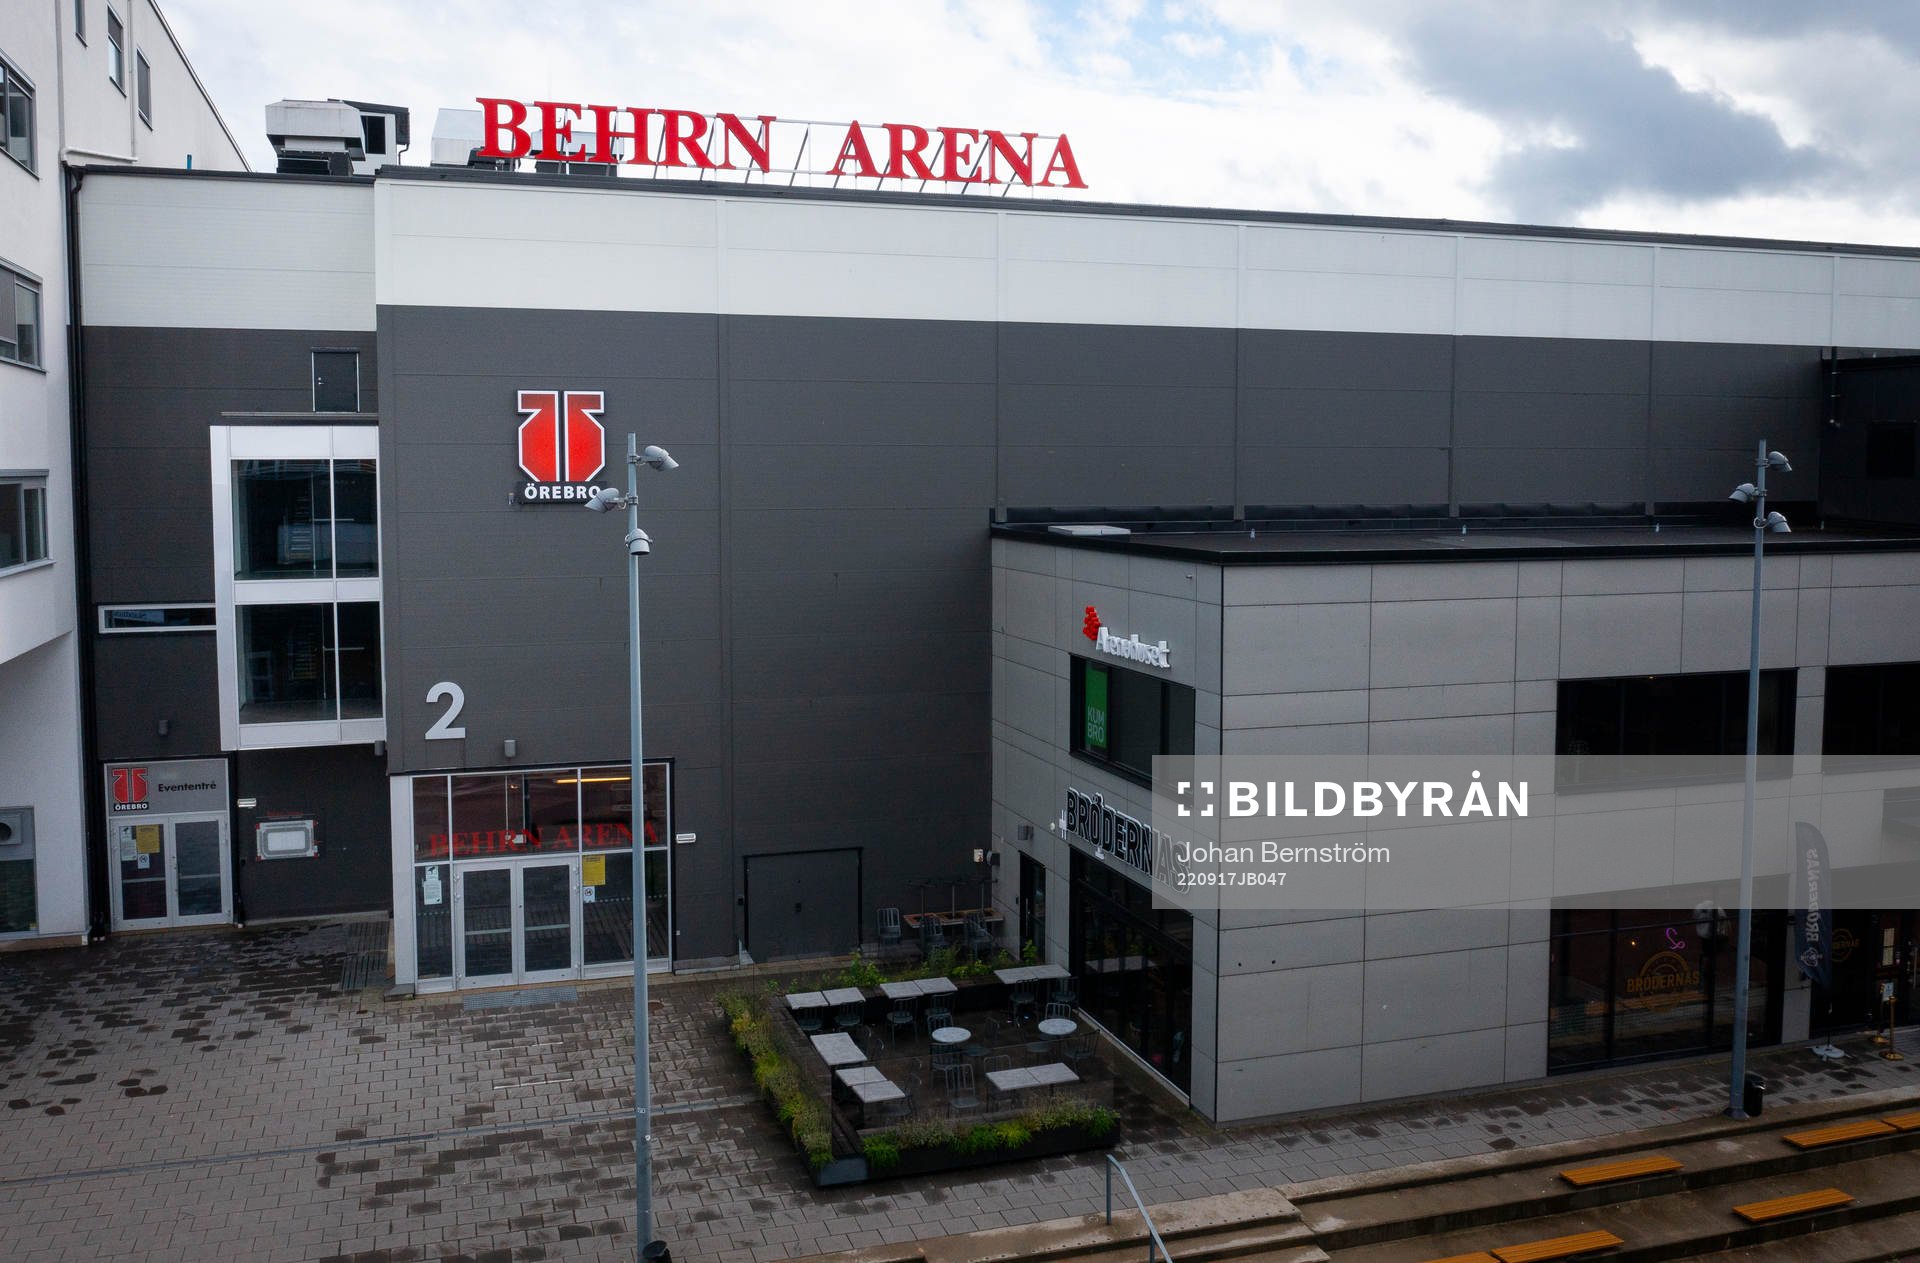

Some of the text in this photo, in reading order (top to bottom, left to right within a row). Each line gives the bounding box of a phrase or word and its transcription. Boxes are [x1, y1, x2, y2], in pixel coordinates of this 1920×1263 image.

[476, 97, 1089, 189] BEHRN ARENA
[524, 483, 601, 499] ÖREBRO
[424, 681, 466, 740] 2
[1088, 705, 1105, 726] KUM
[1088, 722, 1105, 743] BRO
[158, 781, 217, 793] Evententré
[429, 827, 544, 857] BEHRN
[1066, 786, 1191, 895] BRÖDERNAS
